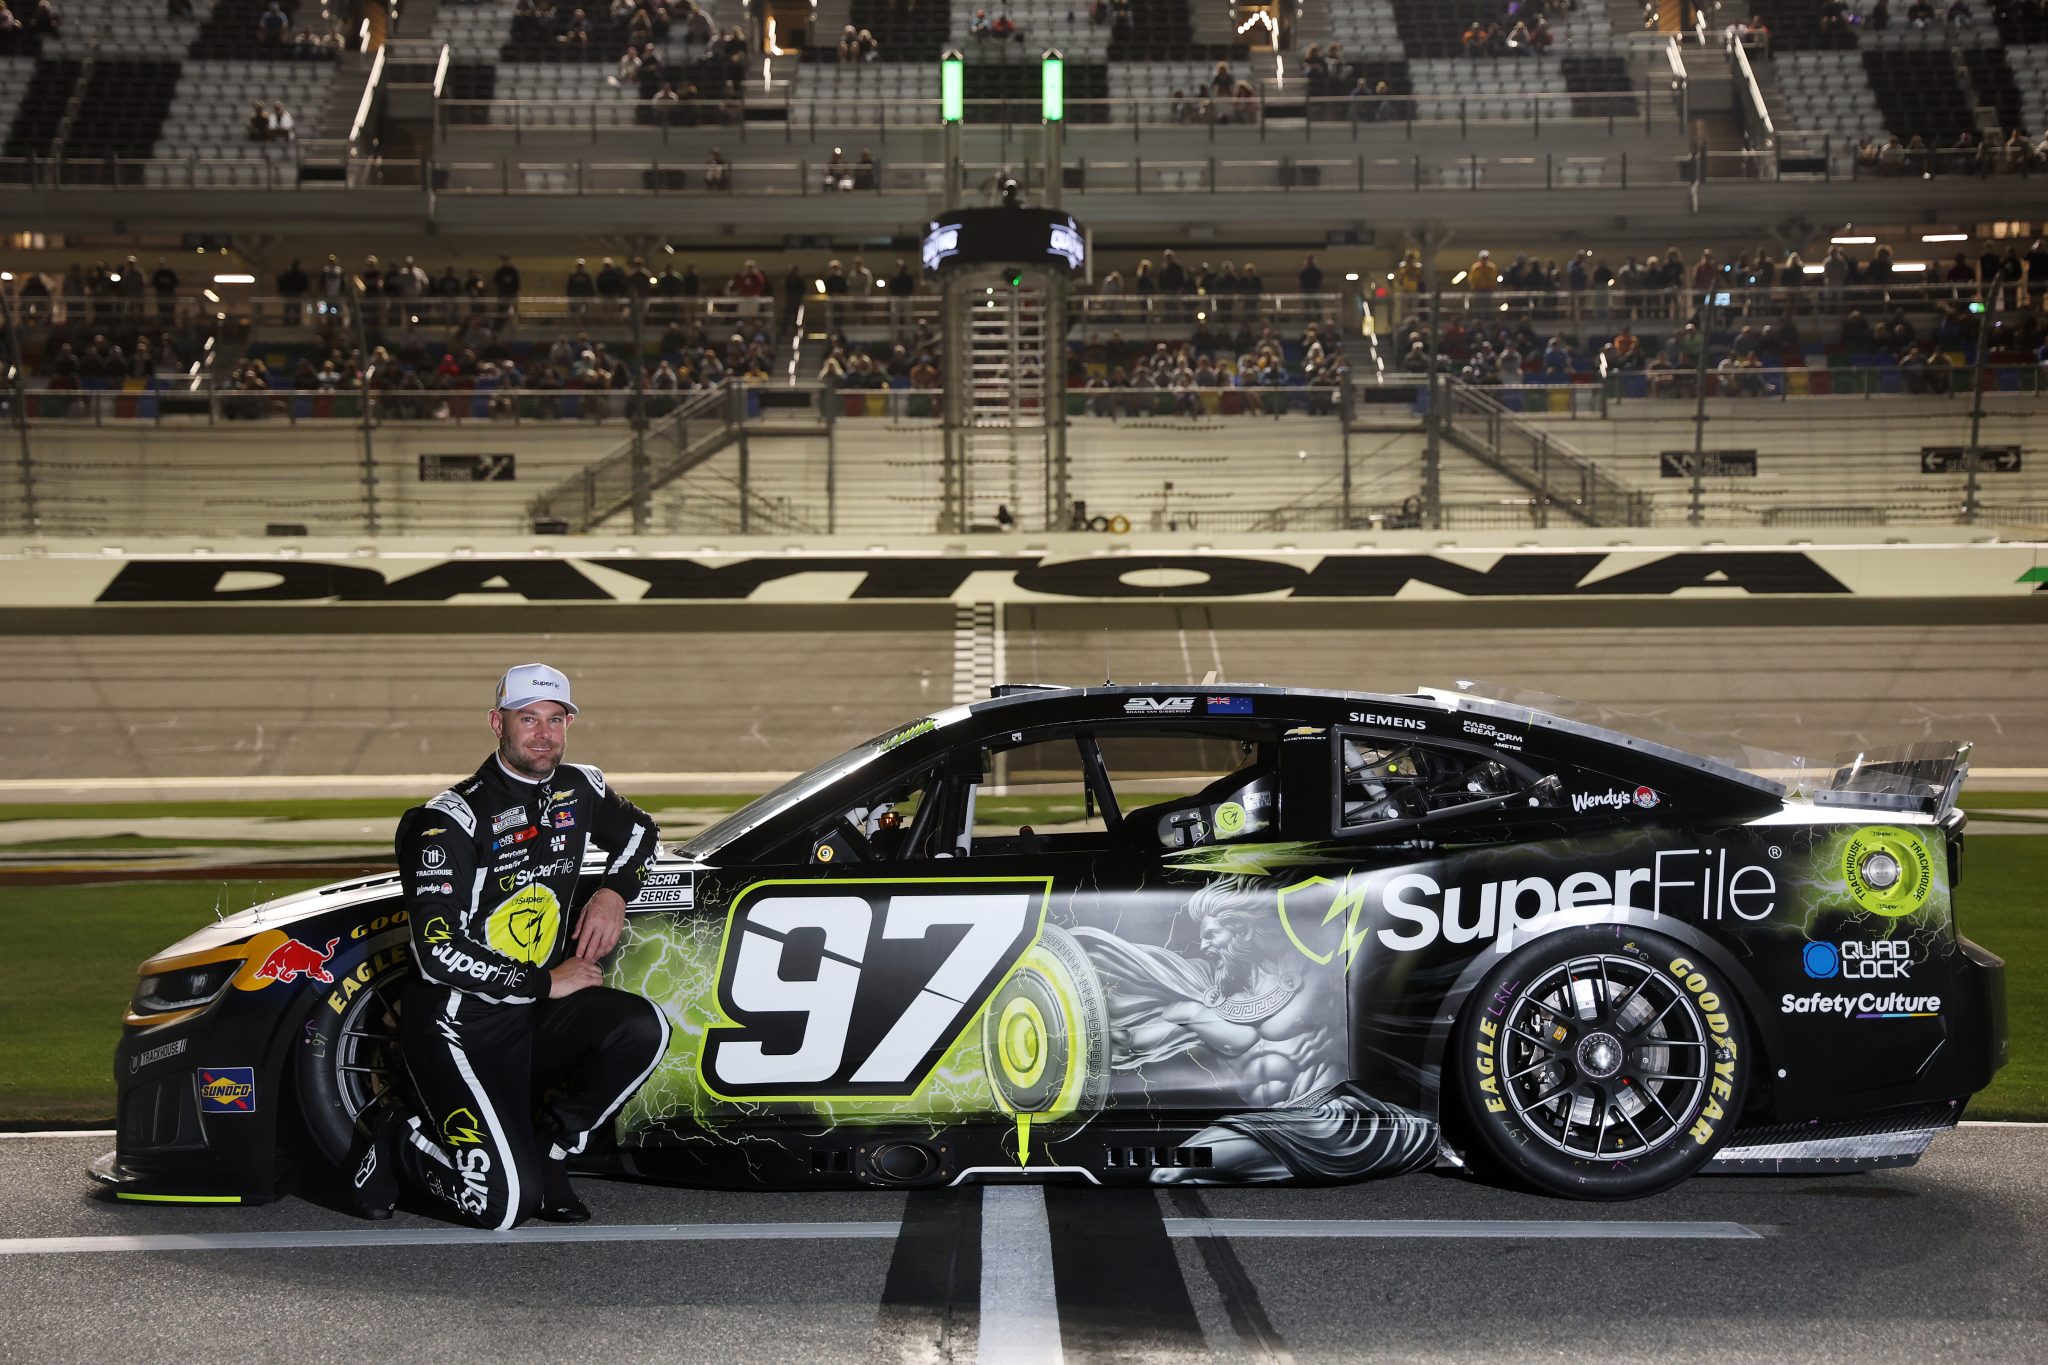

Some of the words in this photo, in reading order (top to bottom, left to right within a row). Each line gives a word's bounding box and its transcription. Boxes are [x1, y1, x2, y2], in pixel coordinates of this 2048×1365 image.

[94, 551, 1856, 603] DAYTONA
[1124, 697, 1198, 710] SVG
[1349, 712, 1427, 730] SIEMENS
[1463, 720, 1496, 731] FARO
[1463, 725, 1523, 743] CREAFORM
[1494, 742, 1522, 751] AMETEK
[1571, 788, 1631, 812] Wendy's
[416, 869, 453, 878] TRACKHOUSE
[1846, 838, 1866, 901] TRACKHOUSE
[1910, 840, 1930, 902] TRACKHOUSE
[416, 883, 440, 896] Wendy's
[640, 890, 681, 903] SERIES
[1841, 940, 1910, 960] QUAD
[327, 946, 408, 1015] EAGLE
[714, 894, 1031, 1085] 97
[1781, 992, 1941, 1019] SafetyCulture
[142, 1041, 180, 1066] TRACKHOUSE
[1669, 957, 1737, 1145] GOODYEAR
[1476, 1016, 1507, 1113] EAGLE
[203, 1085, 250, 1097] SUNOCO
